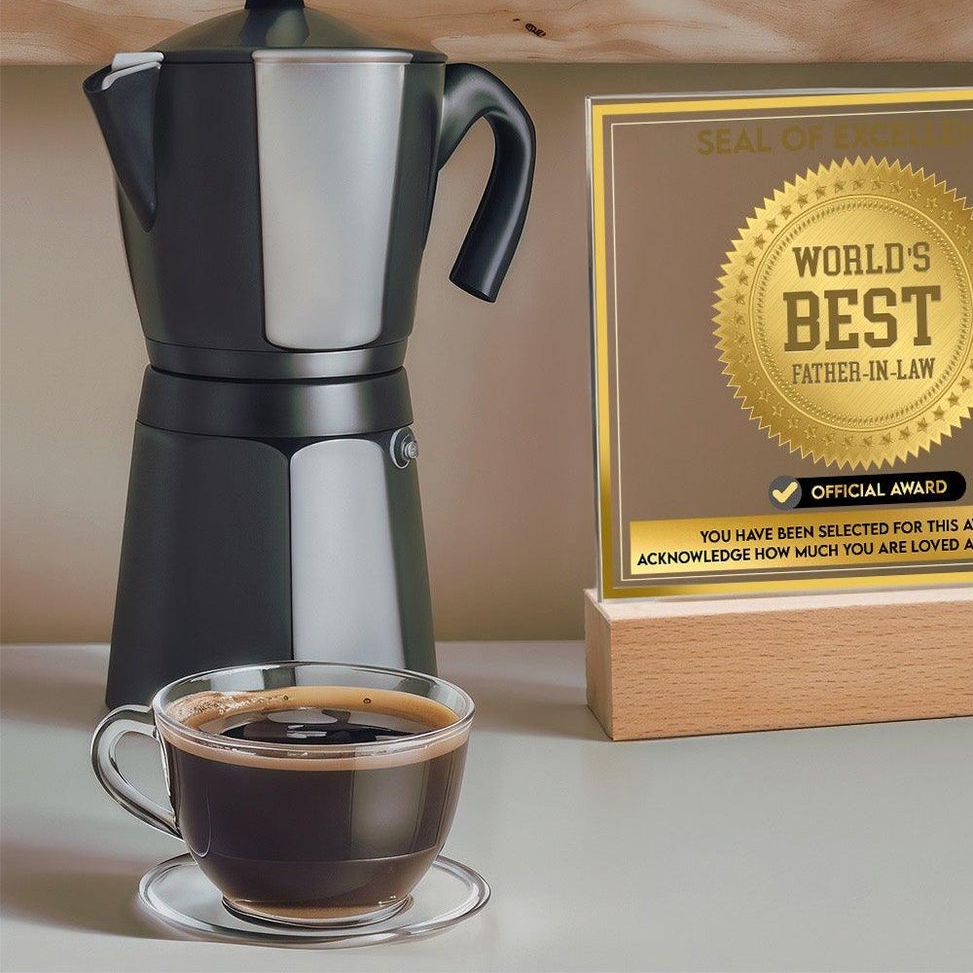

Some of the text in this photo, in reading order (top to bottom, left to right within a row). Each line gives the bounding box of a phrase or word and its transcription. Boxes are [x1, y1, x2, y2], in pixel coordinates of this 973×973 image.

[697, 126, 772, 156] SEAL
[781, 124, 823, 152] OF
[792, 241, 931, 277] WORLD'S
[783, 285, 941, 352] BEST
[792, 357, 936, 385] FATHER-IN-LAW
[811, 479, 948, 500] OFFICIAL AWARD
[700, 529, 731, 543] YOU
[736, 527, 773, 541] HAVE
[777, 526, 814, 540] BEEN
[818, 522, 889, 538] SELECTED
[893, 520, 922, 534] FOR
[927, 519, 959, 532] THIS
[637, 548, 751, 566] ACKNOWLEDGE
[755, 546, 790, 560] HOW
[795, 544, 838, 558] MUCH
[843, 542, 874, 556] YOU
[878, 540, 907, 554] ARE
[911, 538, 959, 553] LOVED
